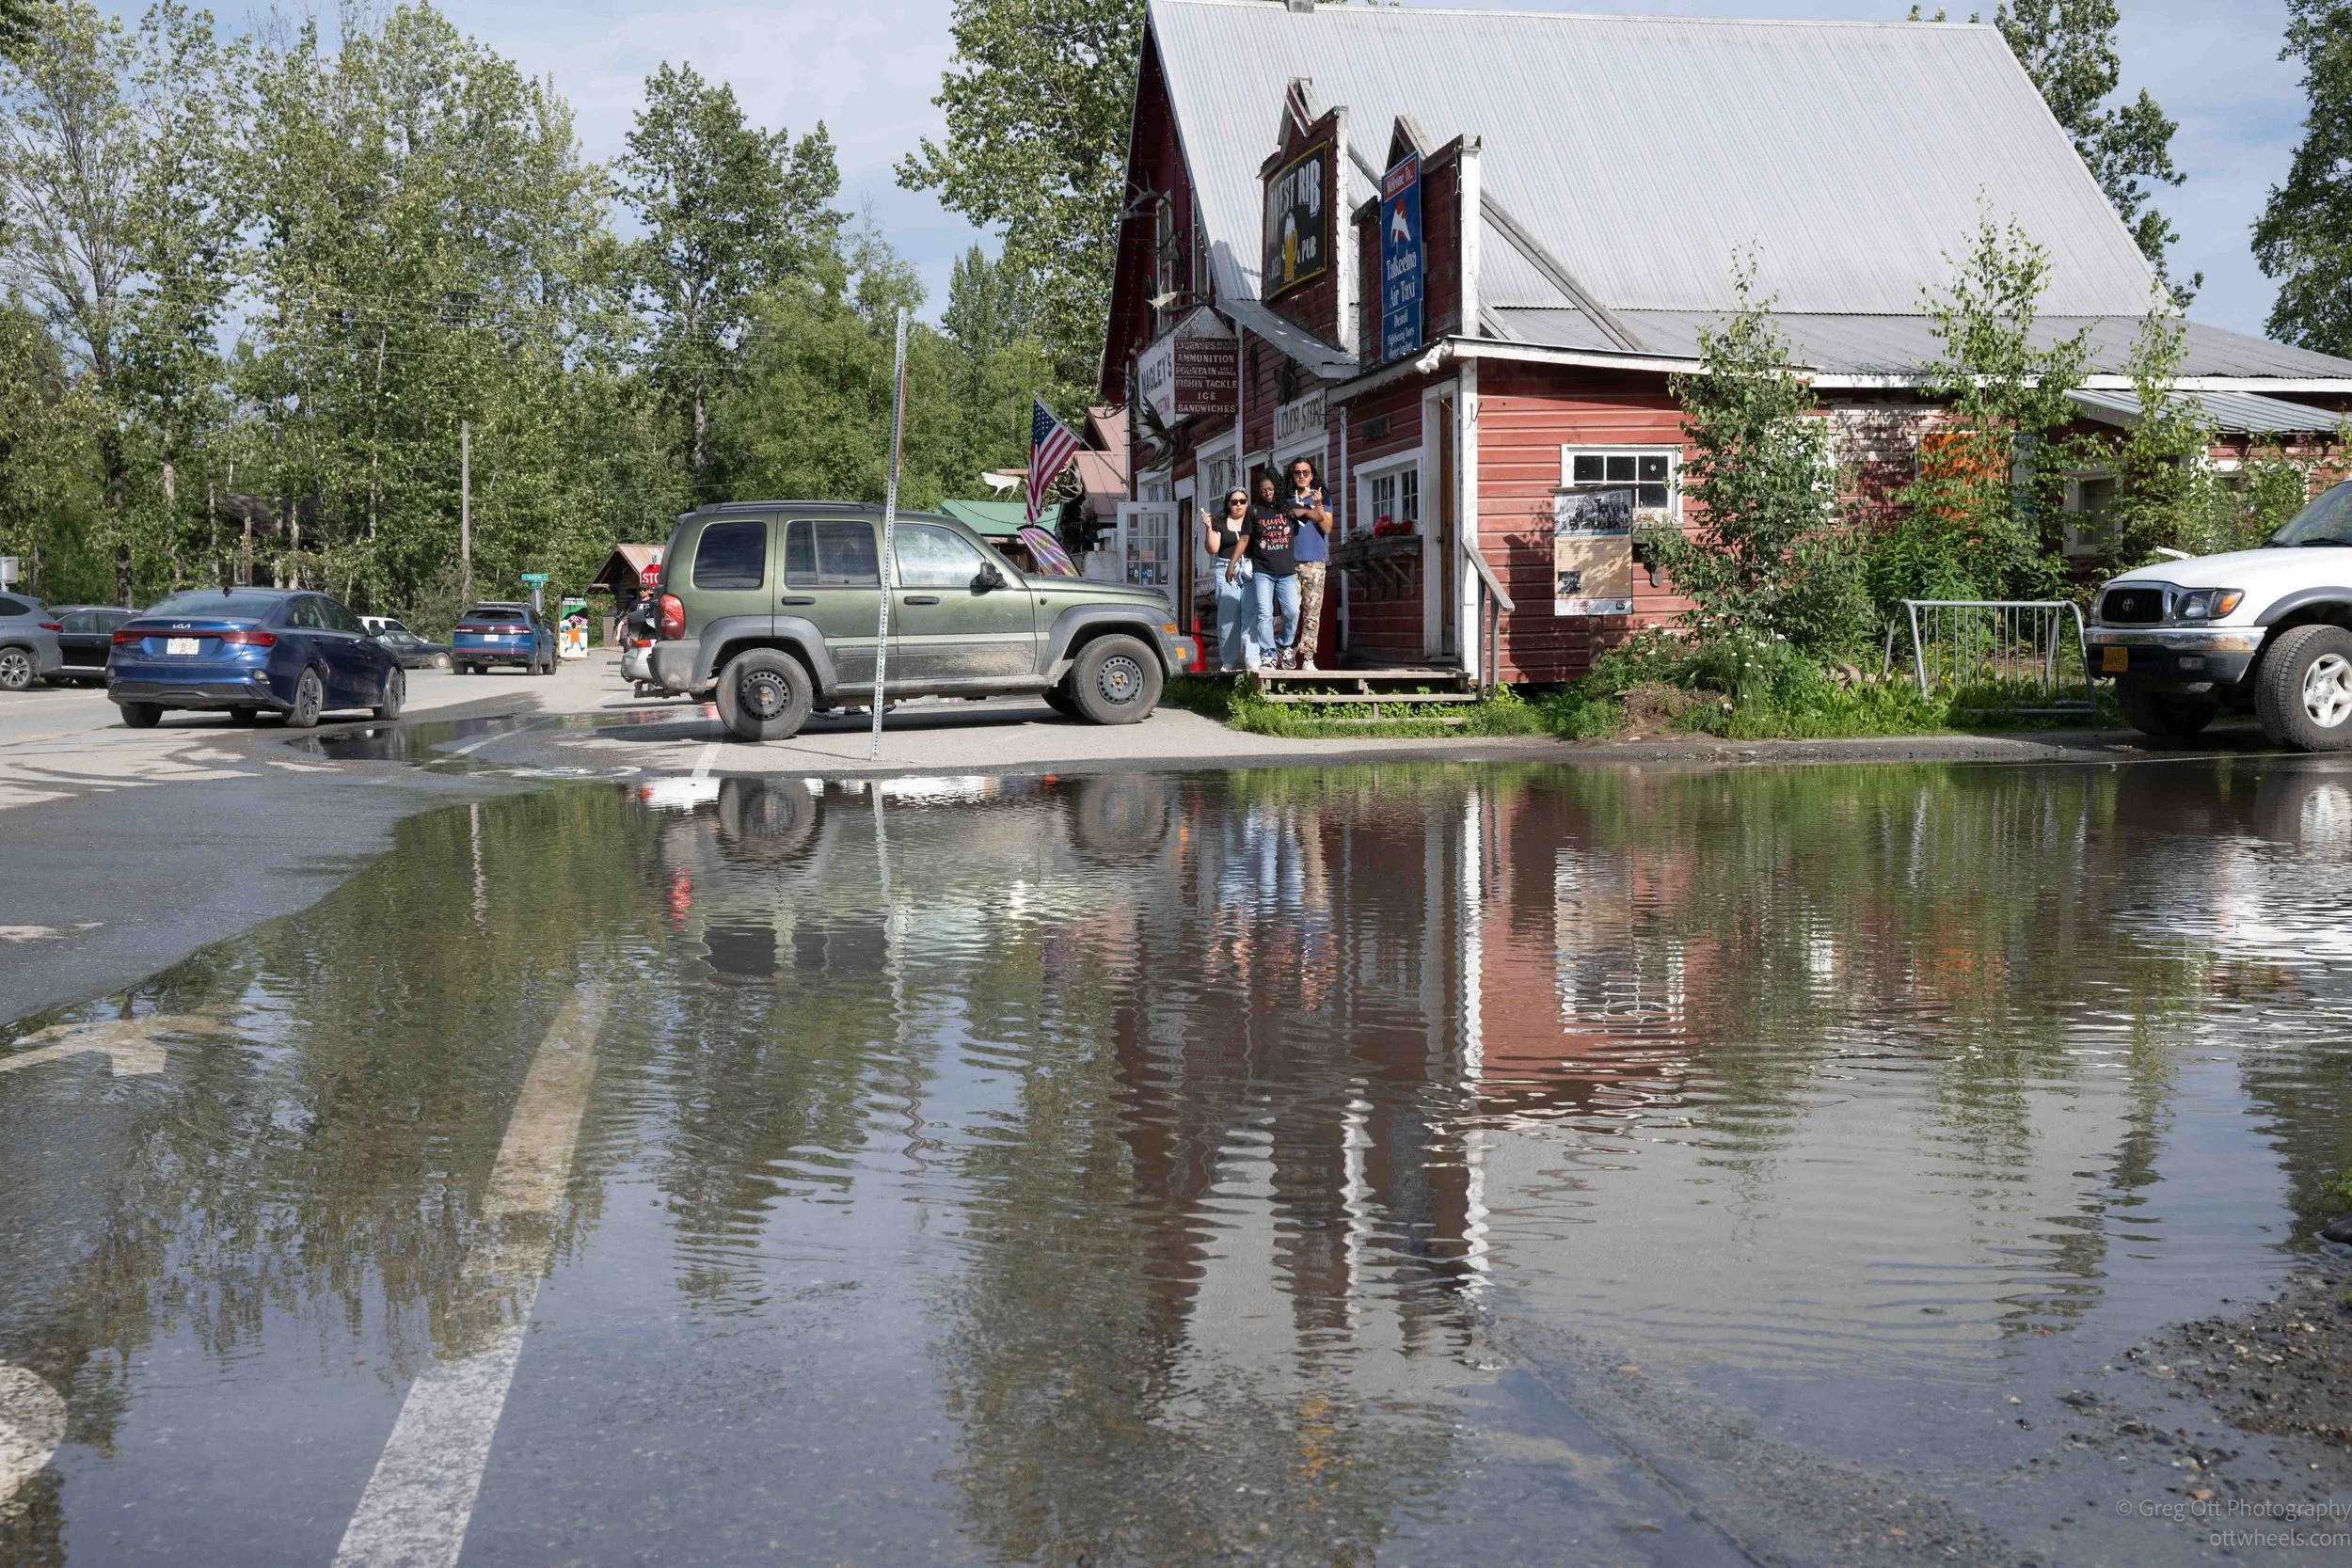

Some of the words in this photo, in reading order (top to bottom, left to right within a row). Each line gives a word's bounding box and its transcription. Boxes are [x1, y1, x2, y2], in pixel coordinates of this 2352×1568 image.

[1269, 174, 1295, 236] WEST
[1297, 158, 1321, 217] RIB
[1301, 235, 1317, 263] PUB
[1386, 249, 1417, 280] Talkeetna
[1390, 285, 1400, 309] Air
[1400, 276, 1416, 302] Taxi
[1175, 366, 1217, 376] FOUNTAIN
[1177, 354, 1235, 363] AMMUNITION
[1141, 350, 1173, 397] NAGLEY'S
[1205, 380, 1238, 388] TACKLE
[1177, 404, 1236, 413] SANDWICHES
[1198, 391, 1216, 401] ICE
[1277, 405, 1299, 440] LIQUOR
[1301, 395, 1324, 433] STORE
